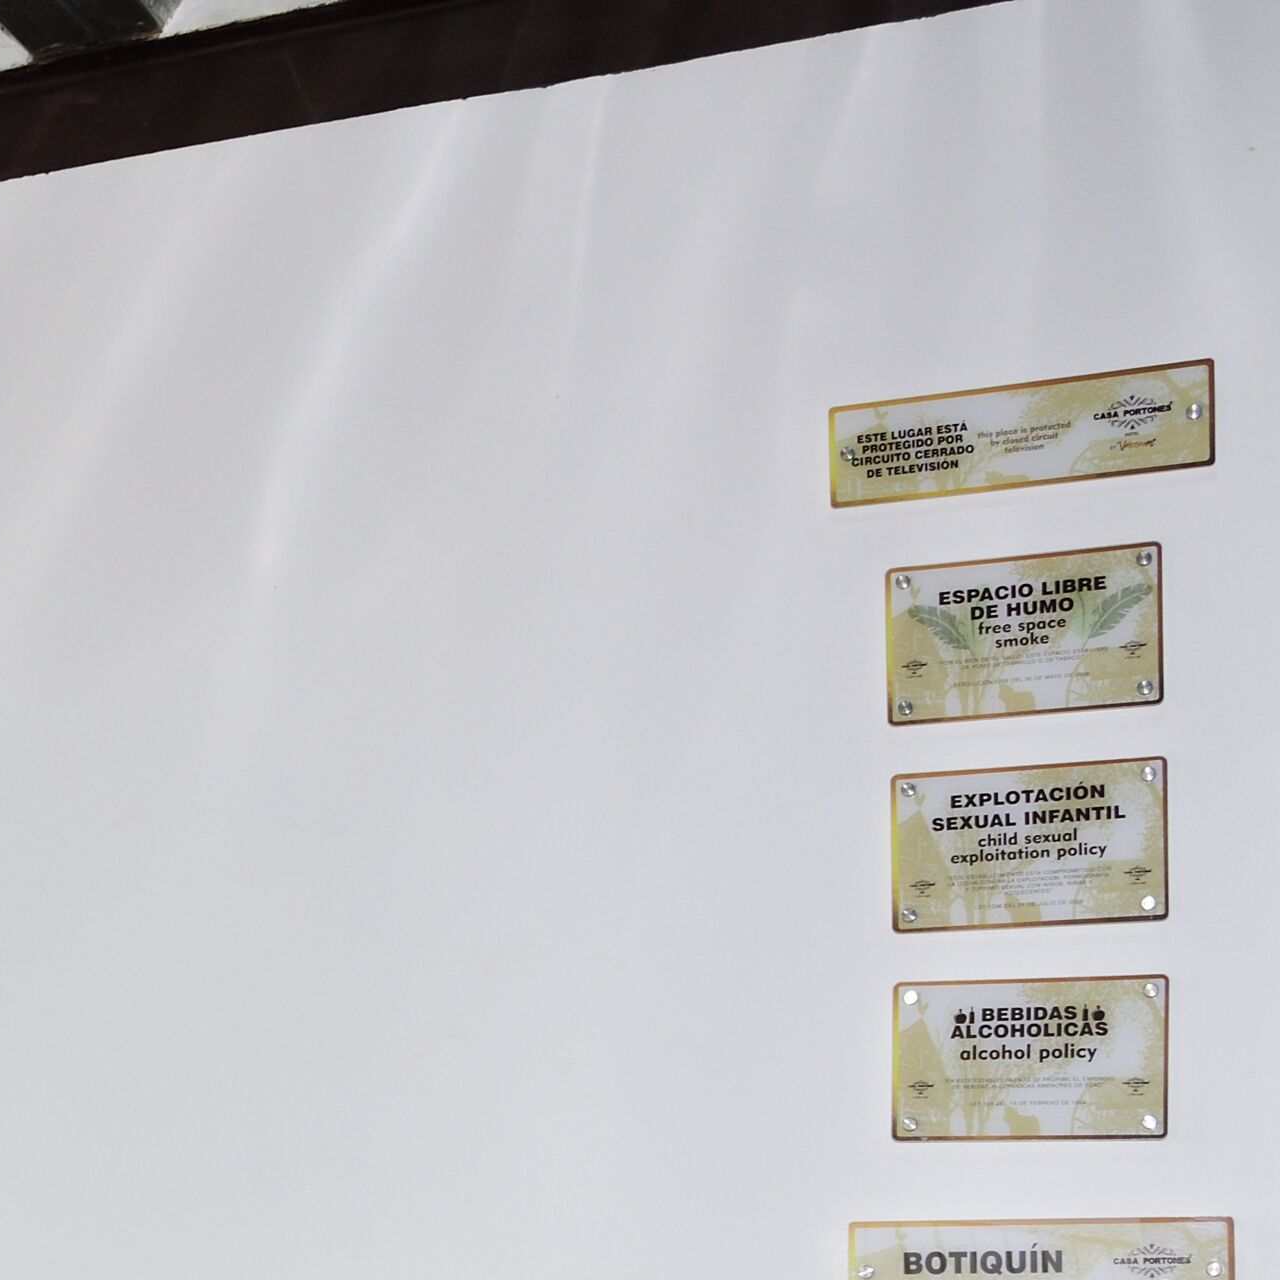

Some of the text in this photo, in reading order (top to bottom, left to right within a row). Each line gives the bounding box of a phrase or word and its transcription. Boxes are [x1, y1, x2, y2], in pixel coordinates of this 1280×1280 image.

[1093, 402, 1172, 421] CASA PORTONES
[857, 420, 968, 444] ESTE LUGAR ESTÁ
[977, 431, 993, 439] this
[995, 427, 1018, 439] place
[1030, 421, 1071, 434] protected
[1002, 436, 1029, 446] closed
[1031, 432, 1058, 443] circuit
[862, 434, 963, 454] PROTEGIDO POR
[1004, 443, 1044, 454] television
[851, 444, 975, 467] CIRCUITO CERRADO
[867, 458, 959, 478] DE TELEVISIÓN
[938, 576, 1107, 605] ESPACIO LIBRE
[970, 597, 1074, 620] DE HUMO
[978, 617, 1066, 635] free space
[995, 633, 1049, 648] smoke
[950, 782, 1105, 809] EXPLOTACIÓN
[932, 806, 1126, 832] SEXUAL INFANTIL
[978, 828, 1077, 847] child sexual
[951, 843, 1107, 866] exploitation policy
[981, 1006, 1077, 1022] BEBIDAS
[950, 1022, 1109, 1039] ALCOHOLICAS
[960, 1043, 1098, 1063] alcohol policy
[903, 1243, 1063, 1275] BOTIQUÍN
[1113, 1255, 1191, 1265] CASA PORTONES
